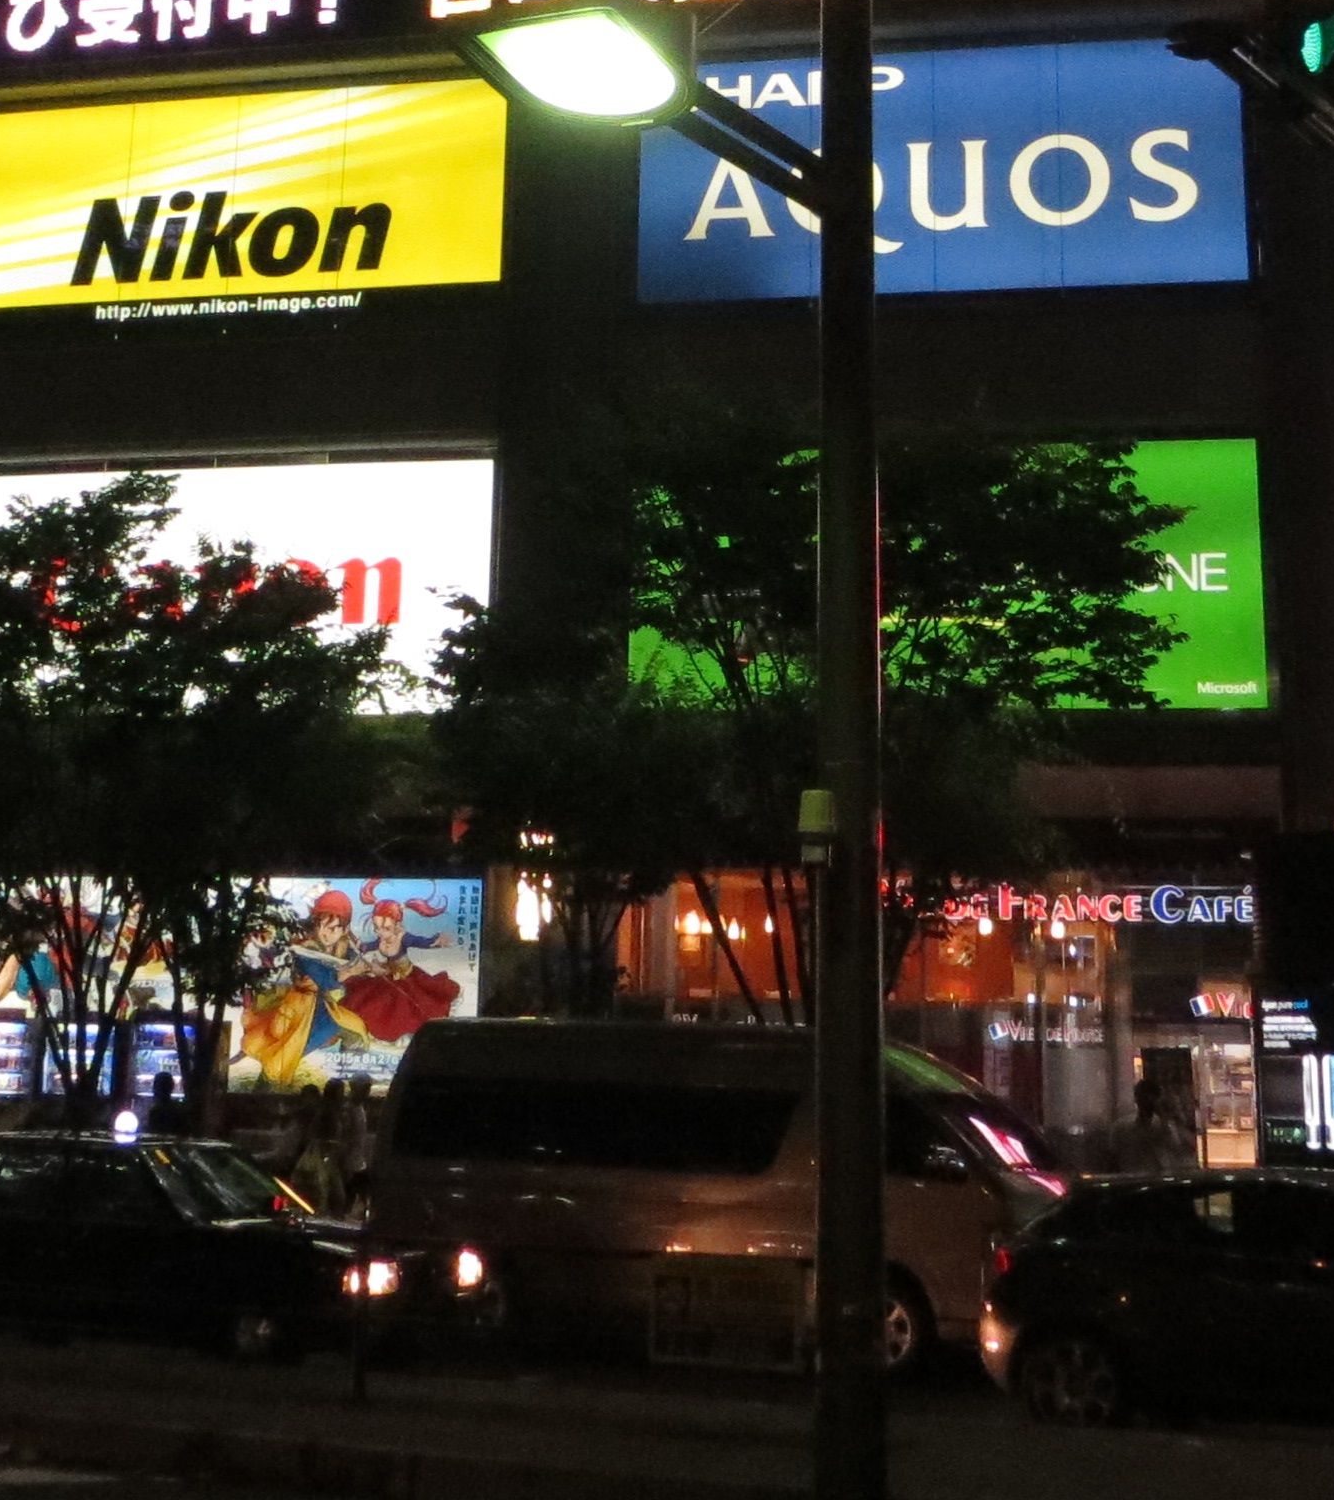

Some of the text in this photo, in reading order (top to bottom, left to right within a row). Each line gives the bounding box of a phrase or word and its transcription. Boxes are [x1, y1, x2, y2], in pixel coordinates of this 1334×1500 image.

[705, 64, 906, 111] HAP
[69, 190, 392, 287] Nikon
[95, 292, 362, 322] http://www.nikon-image.com/
[1197, 680, 1259, 696] Microsoft
[998, 883, 1143, 922] FRANCE
[1150, 884, 1256, 925] CAFÉ
